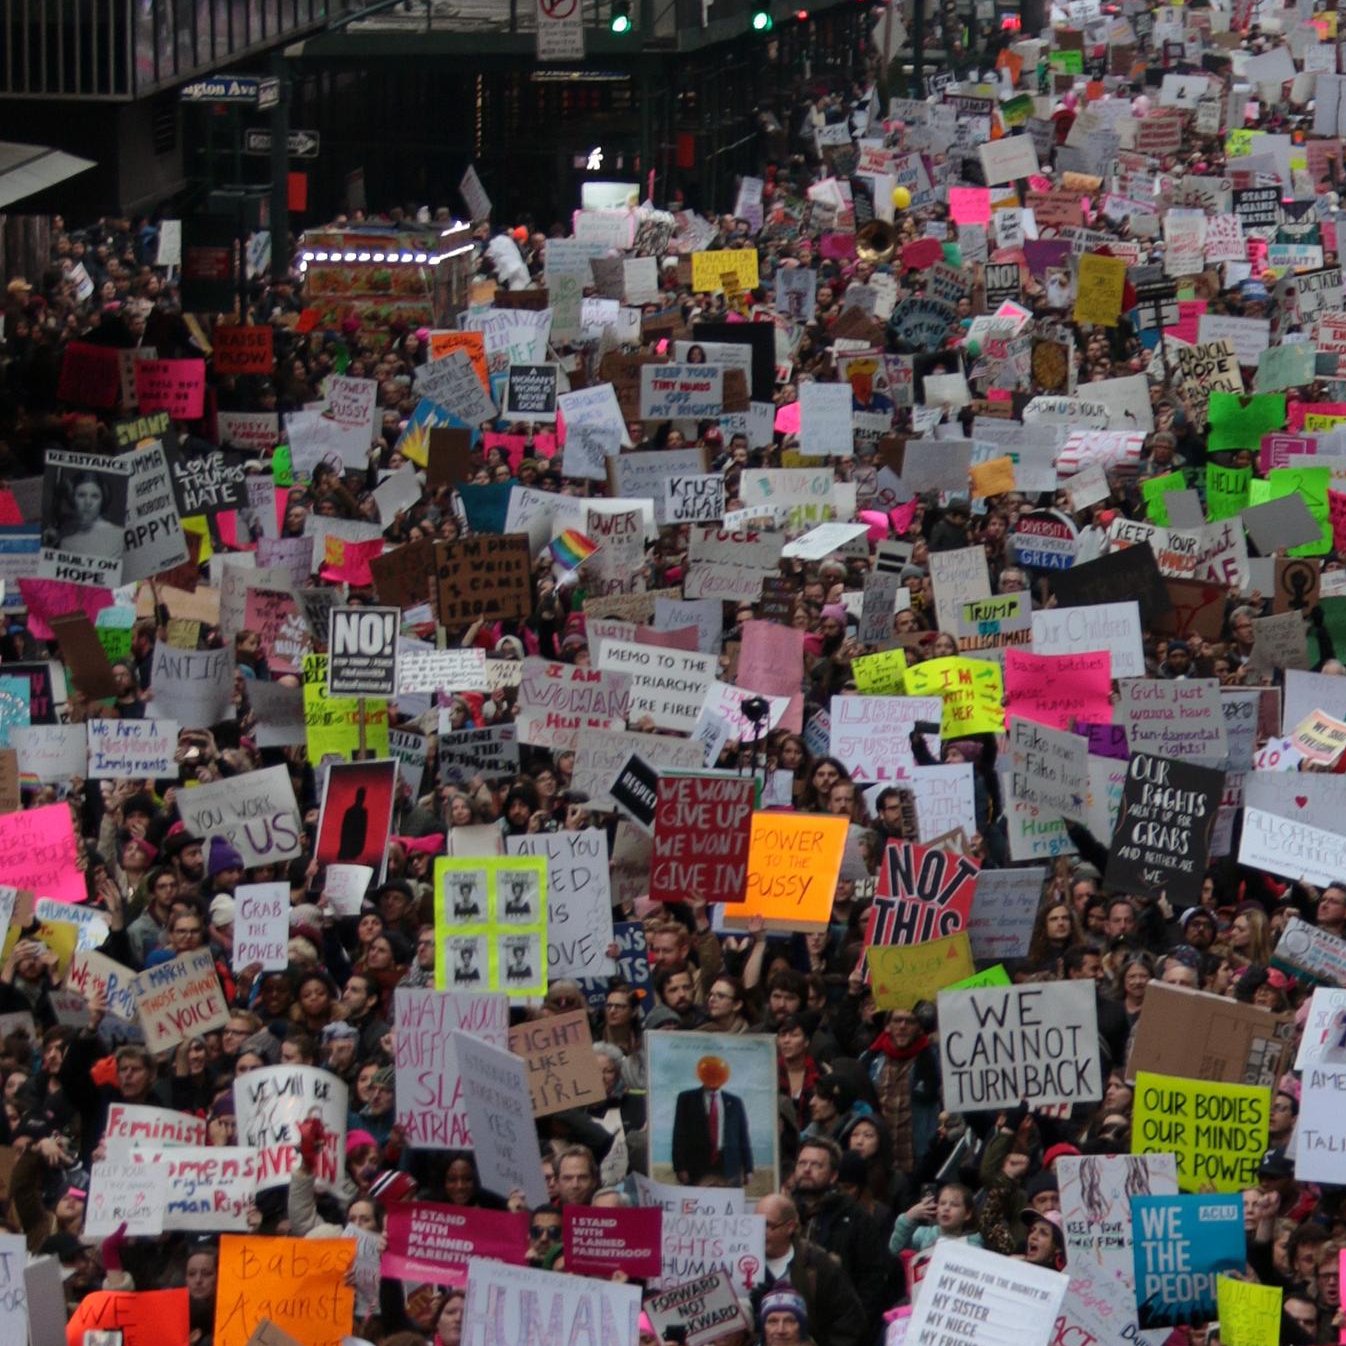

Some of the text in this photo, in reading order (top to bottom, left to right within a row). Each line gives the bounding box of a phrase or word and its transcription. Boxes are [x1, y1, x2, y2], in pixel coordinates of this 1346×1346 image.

[228, 81, 257, 95] Ave
[517, 393, 546, 402] NEVER
[518, 402, 544, 411] DONE
[664, 392, 691, 404] OFF
[647, 405, 672, 418] MY
[47, 452, 130, 473] RESISTANCE
[184, 488, 237, 511] HATE
[56, 568, 105, 585] HOPE
[966, 600, 1018, 622] TRUMP
[336, 613, 394, 655] NO!
[608, 648, 708, 672] MEMO TO THE
[943, 689, 975, 705] WITH
[1131, 684, 1203, 702] Girls just
[952, 705, 975, 719] HER
[1129, 705, 1211, 719] wanna have
[661, 779, 697, 801] WE
[662, 805, 748, 829] GIVE UP
[656, 834, 695, 855] WE
[654, 865, 745, 892] GIVE IN
[240, 897, 283, 918] GRAB
[238, 942, 286, 960] POWER
[970, 990, 1044, 1029] WE
[946, 1026, 1083, 1069] CANNOT
[951, 1058, 1093, 1105] TURN BACK
[1141, 1205, 1183, 1240] WE
[1142, 1240, 1191, 1273] THE
[938, 1275, 985, 1299] MY MOM
[932, 1293, 990, 1321] MY SISTER
